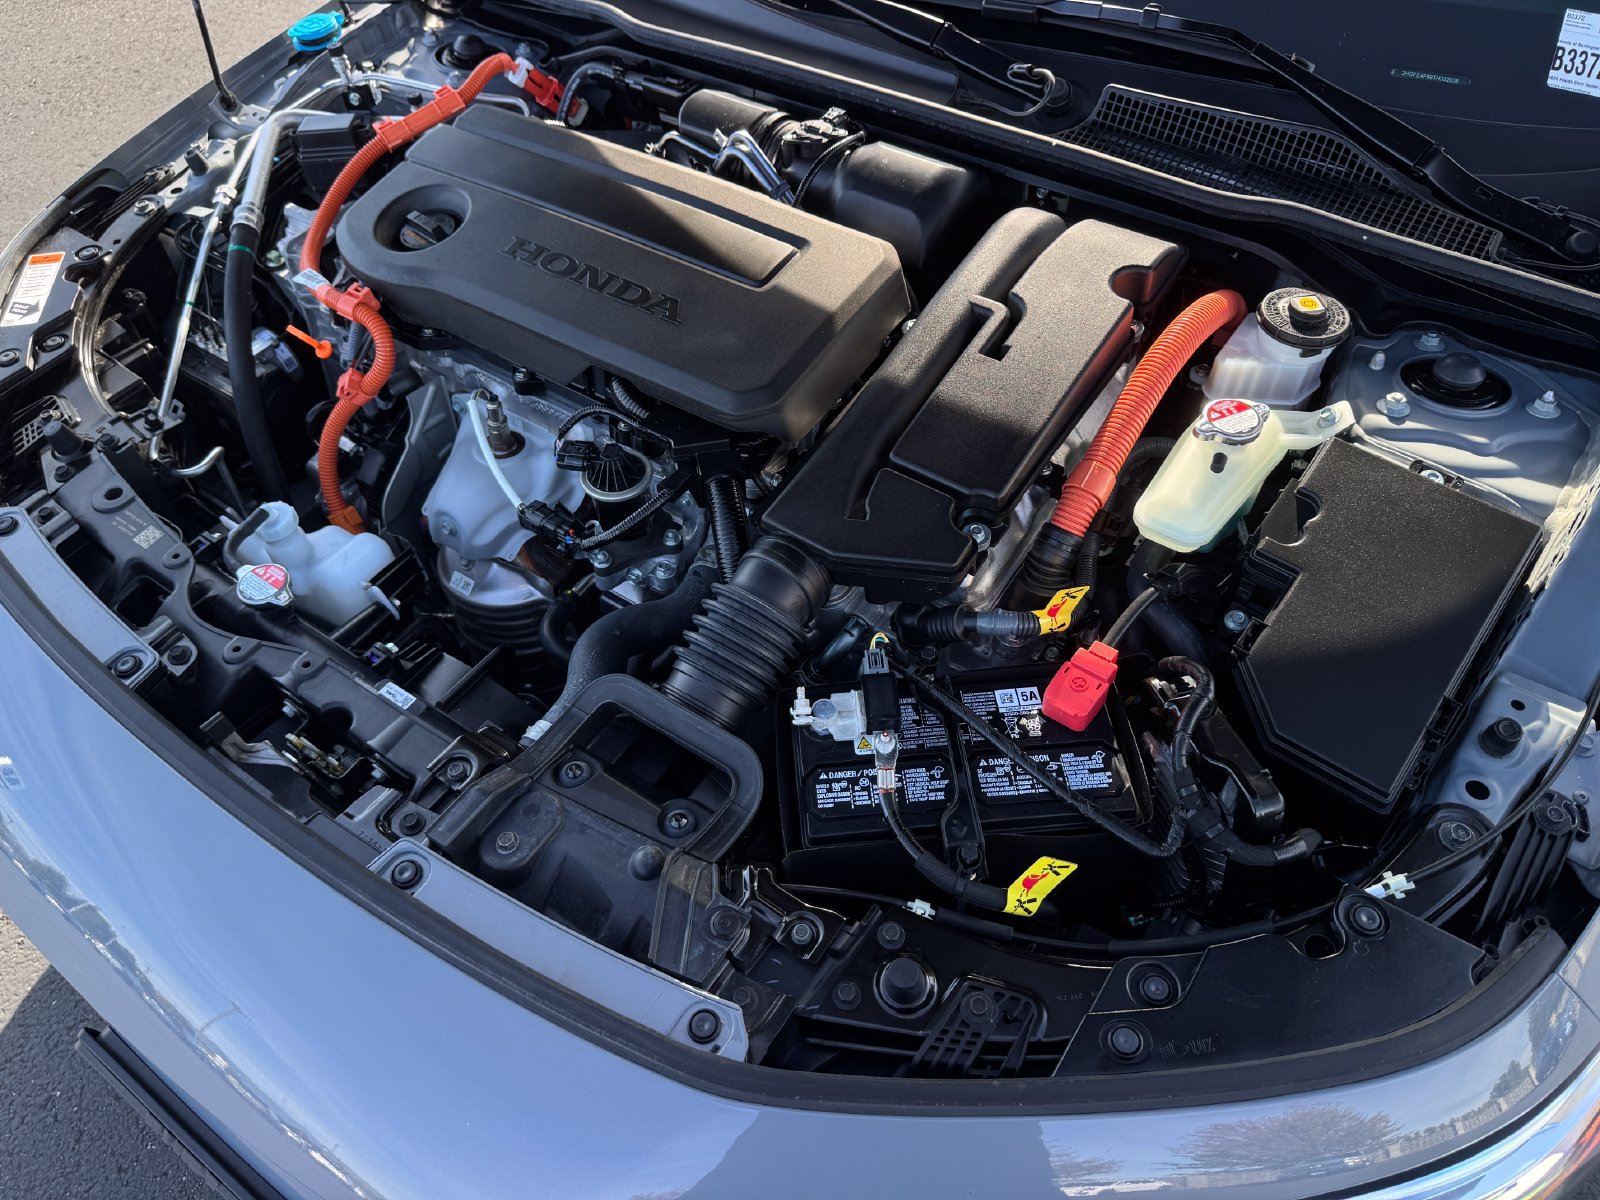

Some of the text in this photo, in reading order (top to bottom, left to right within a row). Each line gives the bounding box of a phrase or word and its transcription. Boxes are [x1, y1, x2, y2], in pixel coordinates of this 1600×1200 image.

[1566, 12, 1586, 21] B3372
[497, 235, 682, 325] HONDA
[1021, 690, 1038, 702] 5A
[989, 758, 1011, 766] DANGE
[828, 770, 856, 779] DANGER
